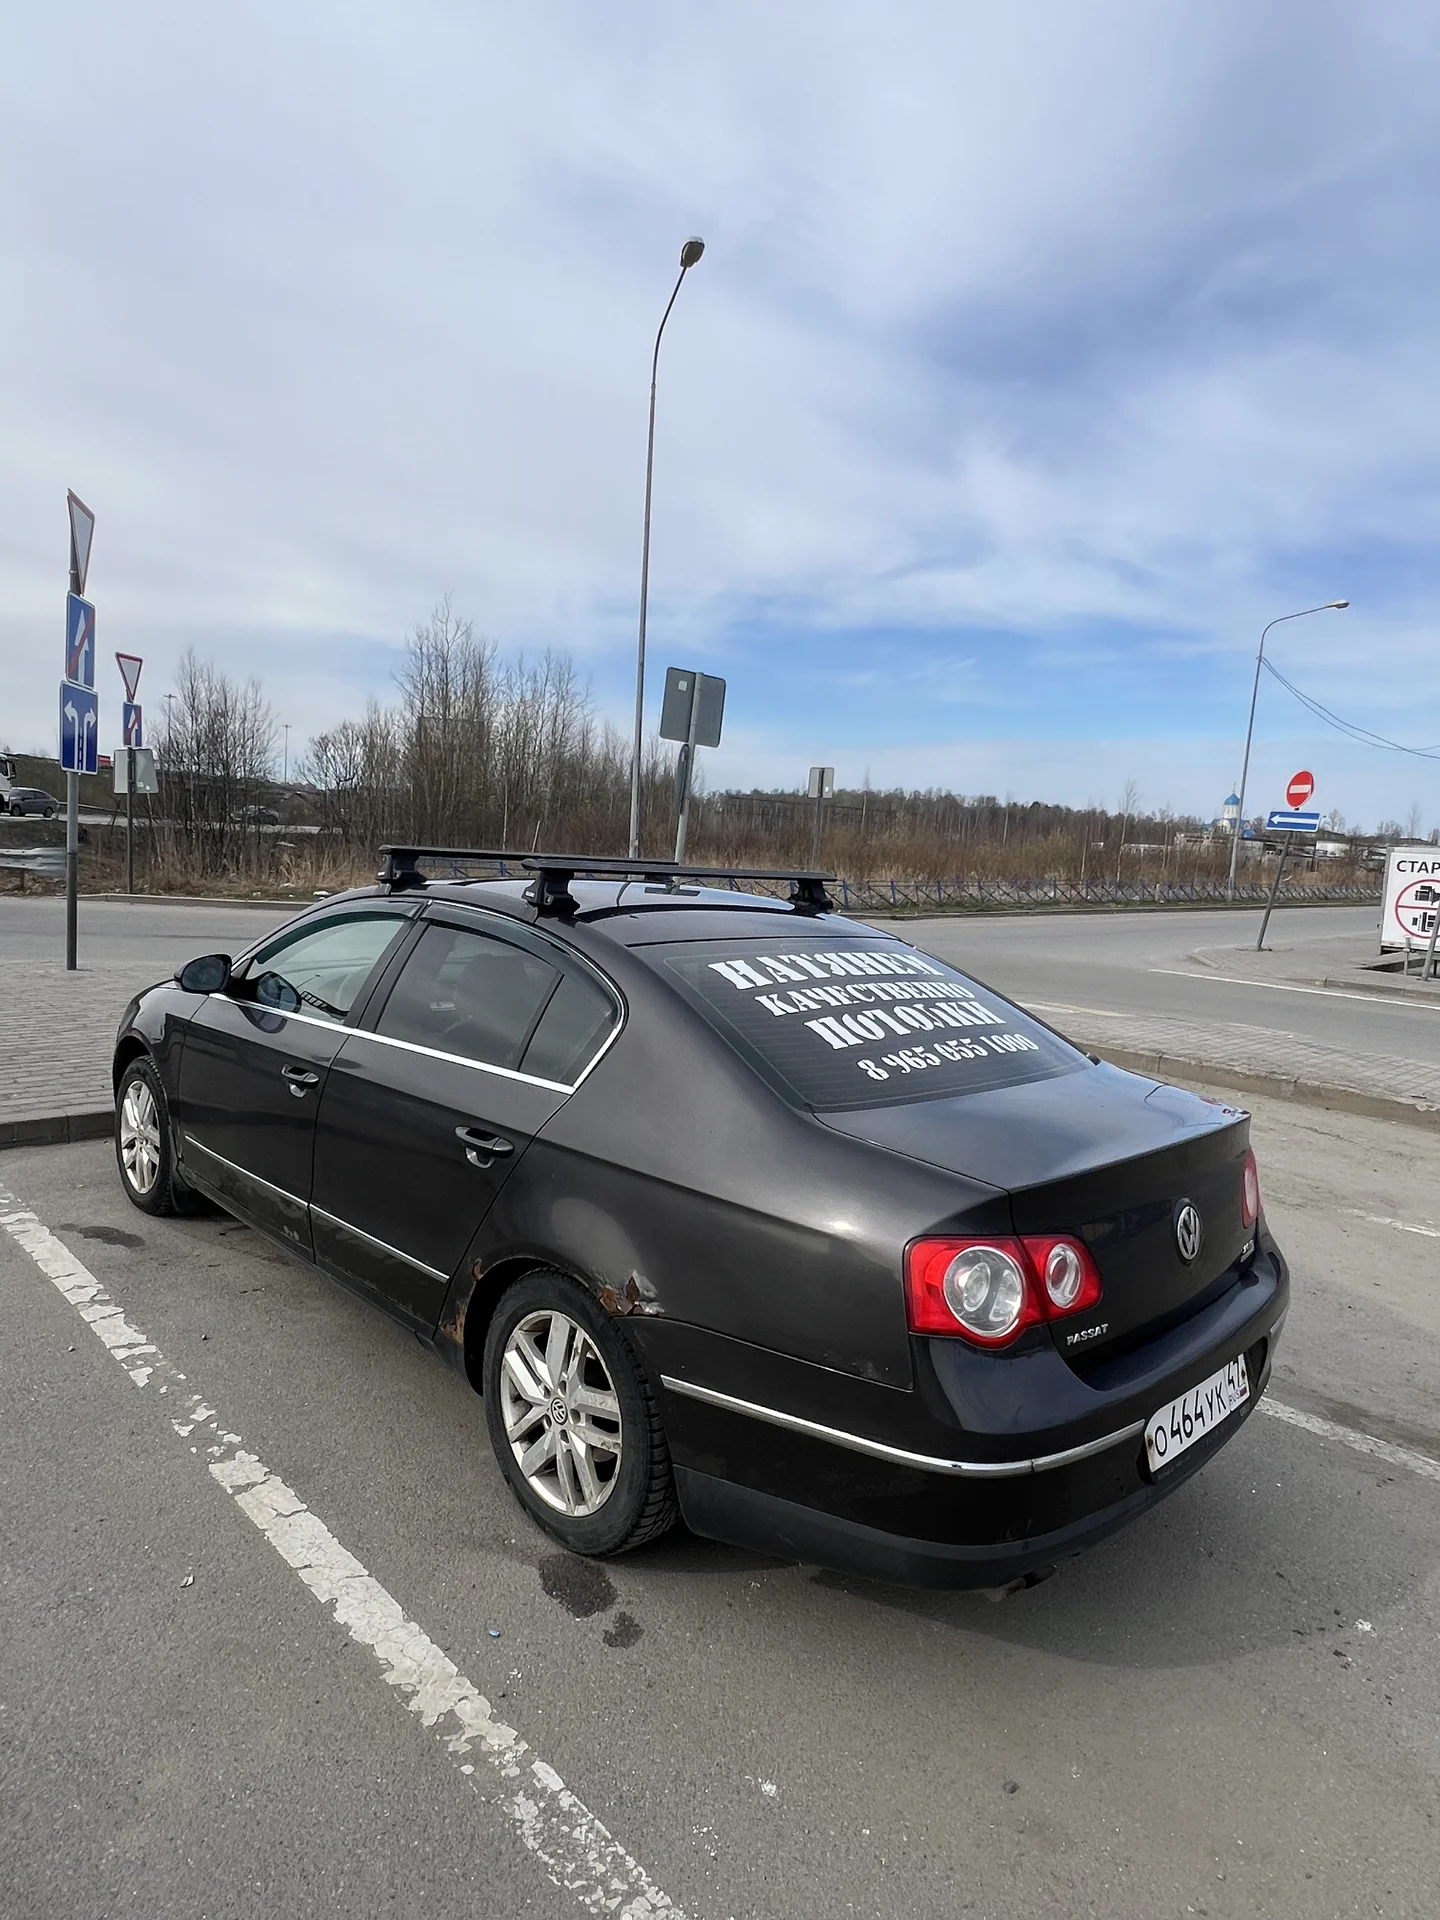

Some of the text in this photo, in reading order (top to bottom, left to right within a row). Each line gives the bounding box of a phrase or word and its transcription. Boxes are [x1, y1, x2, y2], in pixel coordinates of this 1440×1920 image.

[1396, 860, 1440, 874] СТАР
[708, 952, 944, 989] НАТЯНЕМ
[755, 982, 975, 1016] КАЧЕСТВЕННО
[804, 1001, 1006, 1050] ПОТОЛКИ
[857, 1033, 1040, 1081] 8 965 055 1000
[1066, 1323, 1109, 1346] PASSAT
